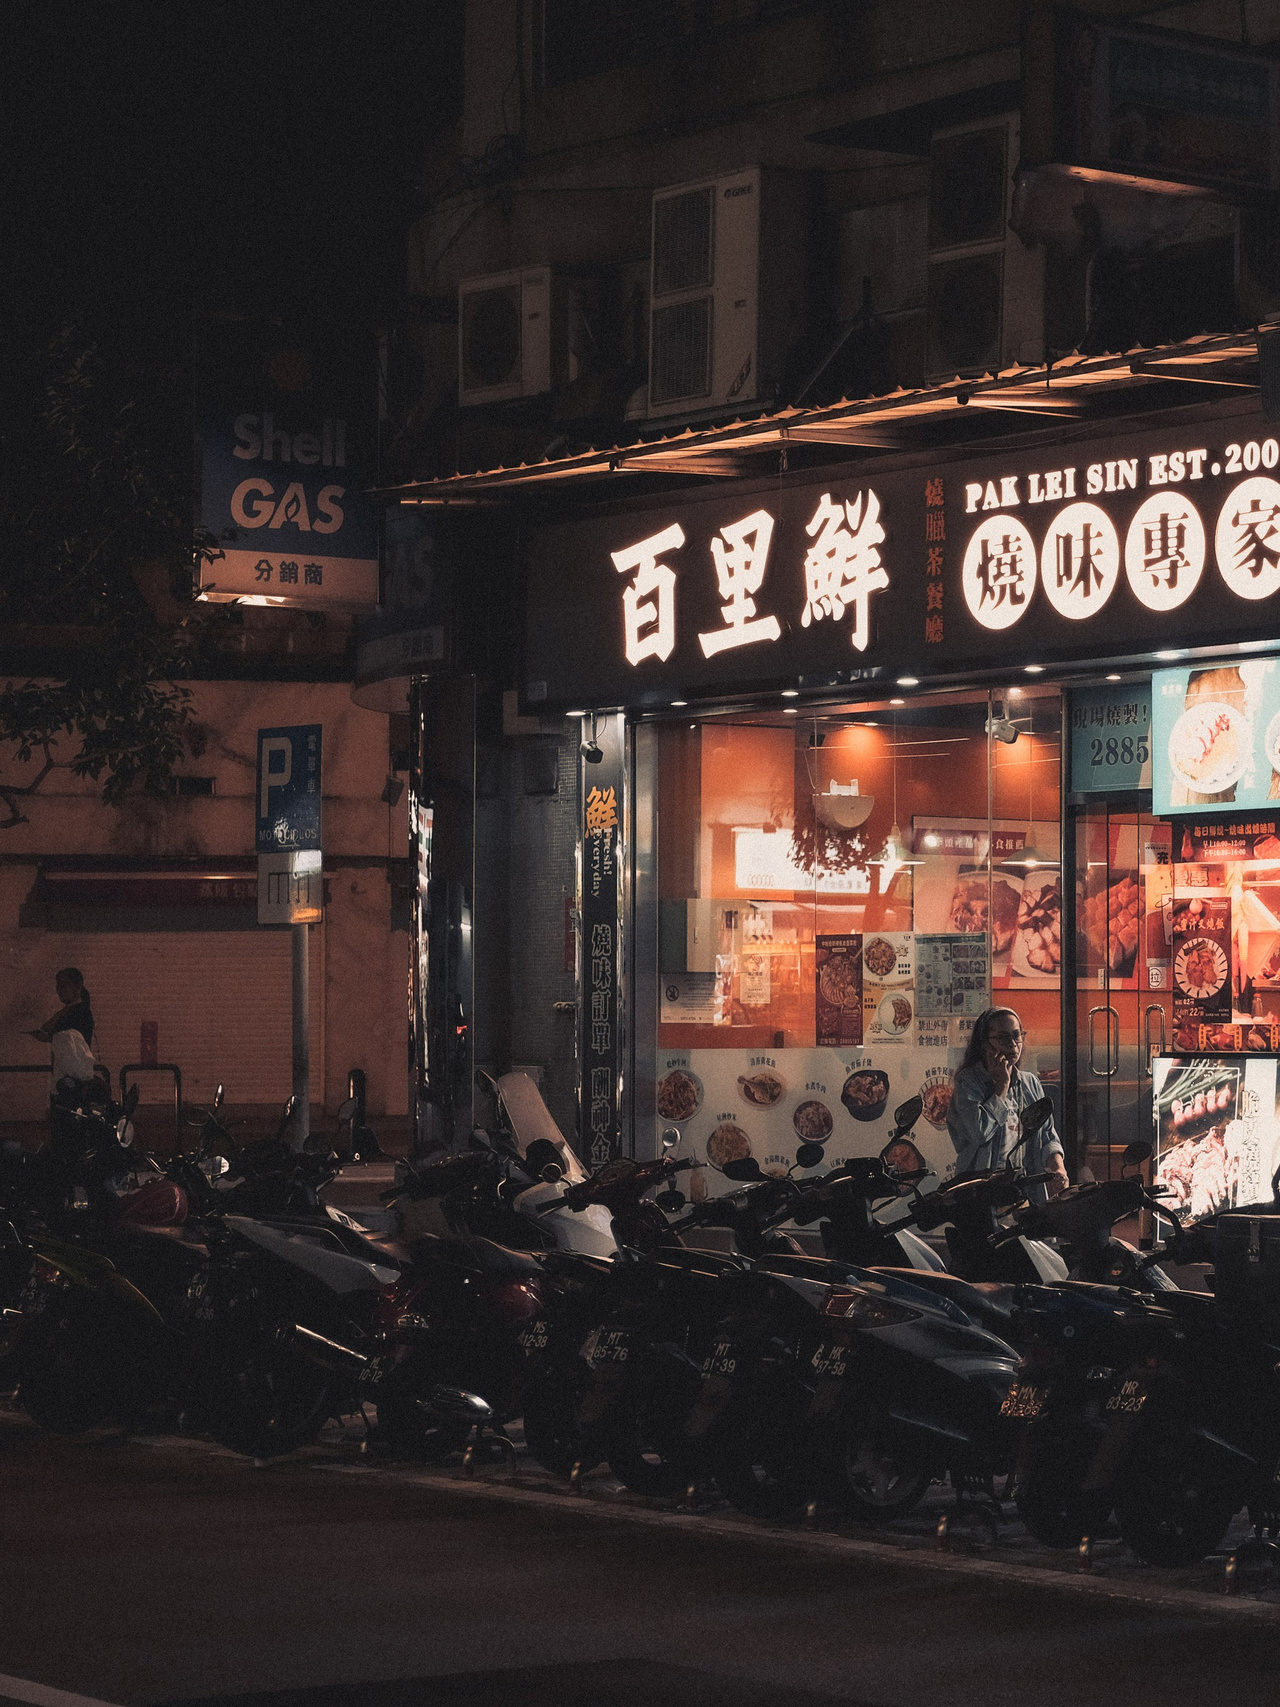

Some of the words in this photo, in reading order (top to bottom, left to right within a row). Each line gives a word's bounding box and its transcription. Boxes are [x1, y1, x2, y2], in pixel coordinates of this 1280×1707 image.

[233, 411, 347, 467] Shell
[230, 477, 346, 534] GAS
[965, 476, 1020, 513] PAK
[1028, 468, 1076, 504] LEI
[1086, 458, 1138, 496] SIN
[254, 559, 323, 586] 分銷商
[611, 488, 890, 666] 百里鮮
[924, 478, 946, 644] 燒臘茶餐廳
[261, 736, 292, 818] P
[306, 734, 317, 793] 電單車
[1090, 735, 1149, 767] 2885
[584, 785, 618, 839] 鮮
[591, 828, 602, 898] Everyday
[603, 828, 613, 875] Fresh!
[591, 1067, 611, 1178] 酬神金
[703, 1358, 737, 1373] 81-39
[715, 1343, 731, 1357] MT
[1121, 1381, 1139, 1395] MR
